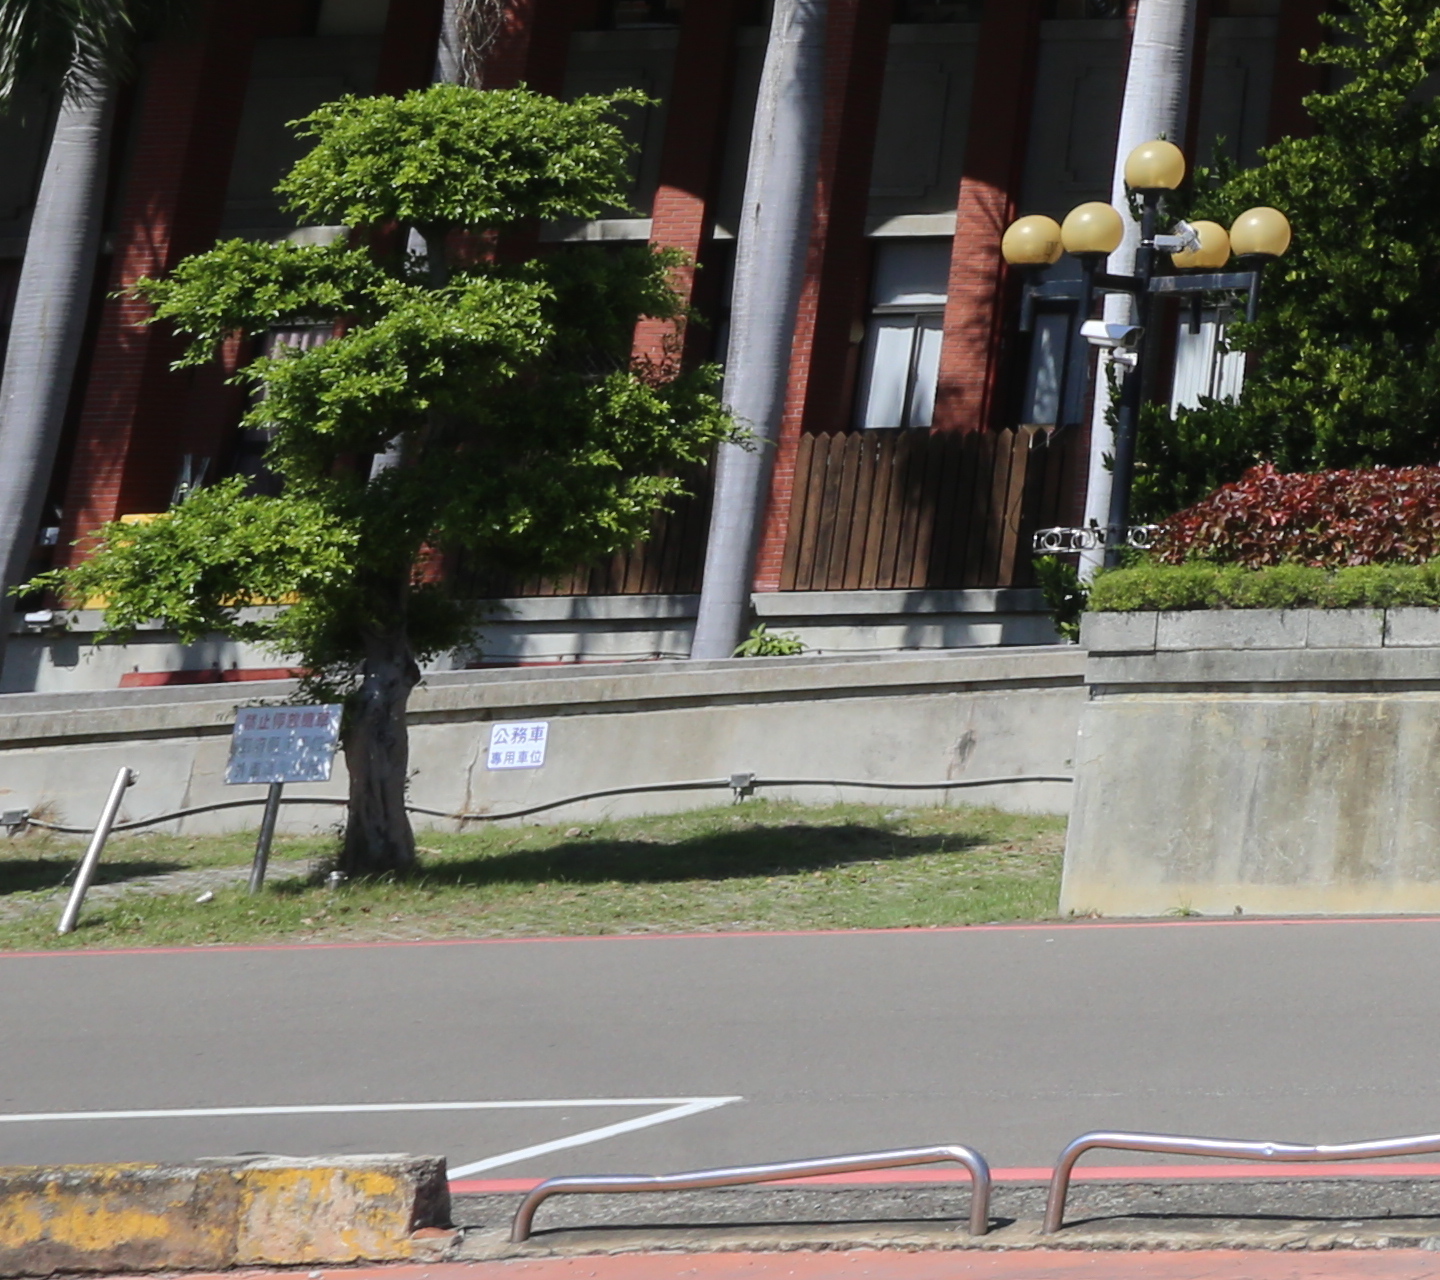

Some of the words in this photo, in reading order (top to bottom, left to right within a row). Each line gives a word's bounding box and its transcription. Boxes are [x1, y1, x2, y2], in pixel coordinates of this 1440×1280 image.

[493, 725, 545, 745] 公務車
[490, 749, 542, 766] 專用車位
